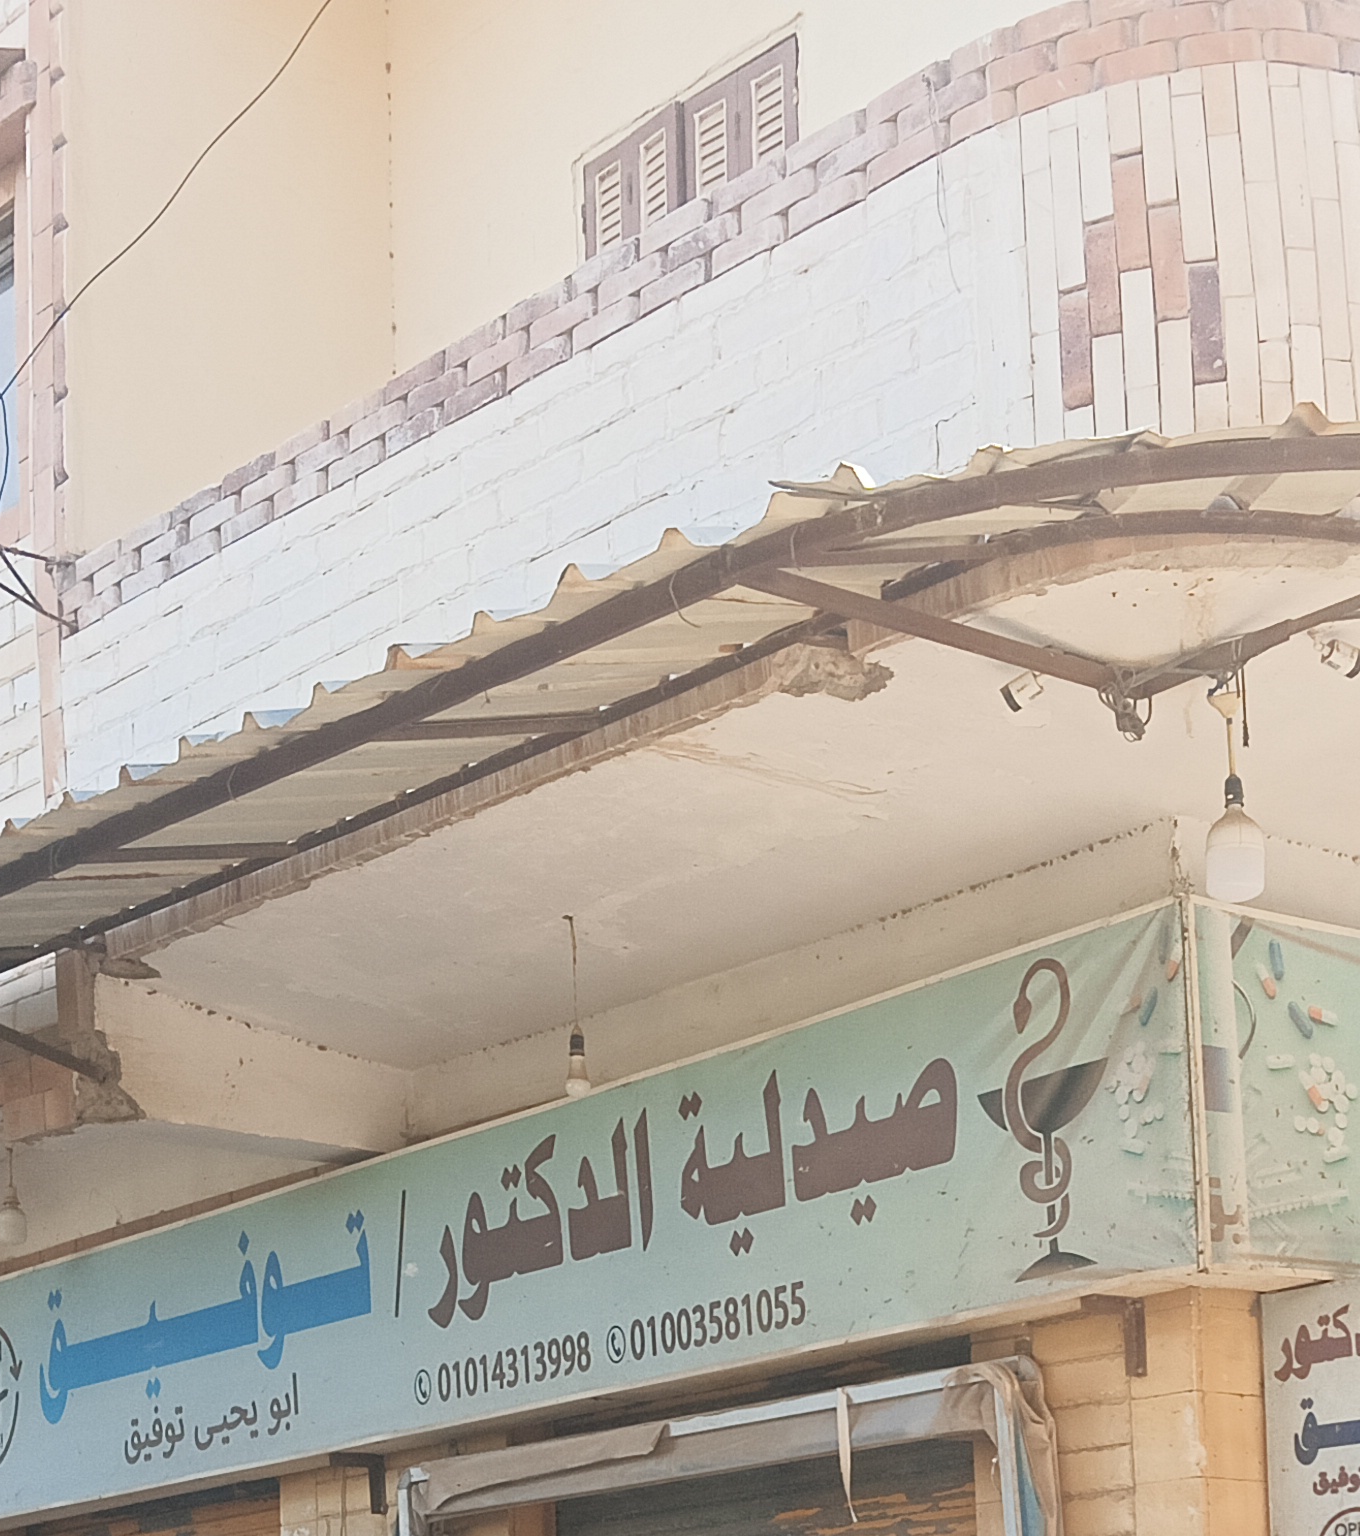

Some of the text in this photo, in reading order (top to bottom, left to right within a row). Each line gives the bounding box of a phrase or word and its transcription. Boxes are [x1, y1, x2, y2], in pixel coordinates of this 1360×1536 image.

[428, 1107, 650, 1328] الدكتور
[680, 1057, 958, 1257] صيدلية
[40, 1209, 372, 1424] توفيق
[438, 1281, 807, 1402] 01014313998 01003581055
[124, 1372, 299, 1464] ابو يحيى توفيق
